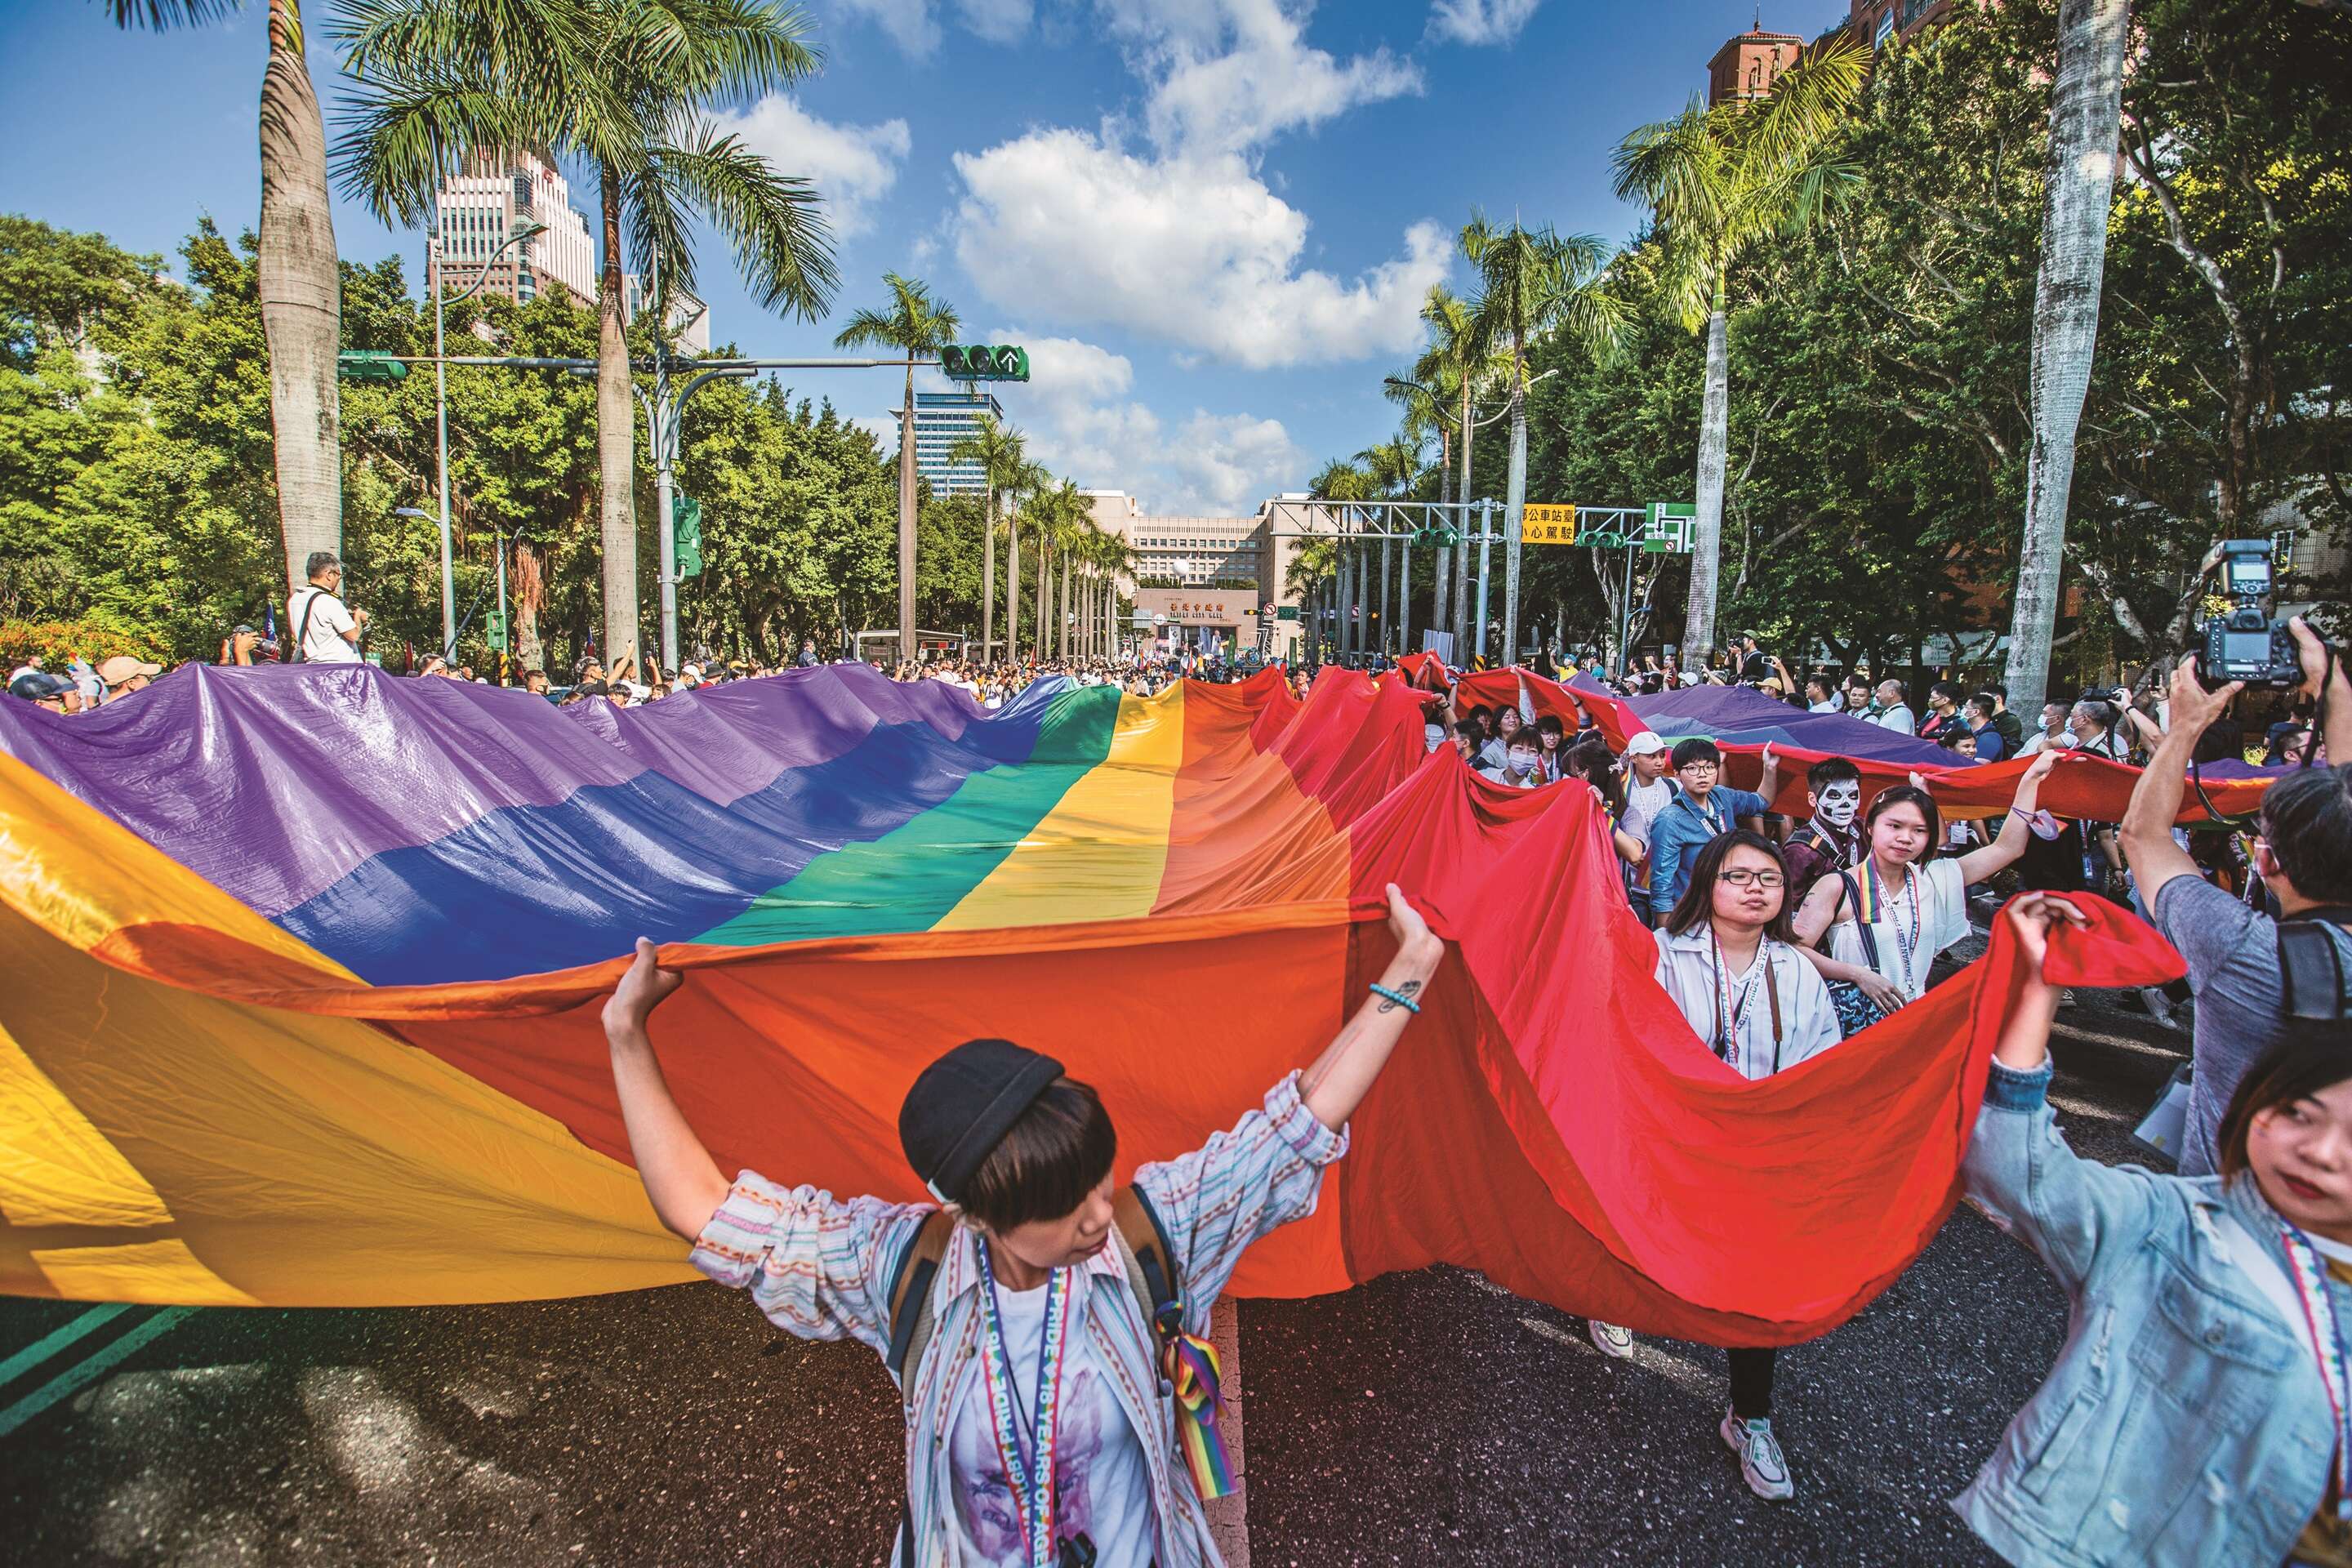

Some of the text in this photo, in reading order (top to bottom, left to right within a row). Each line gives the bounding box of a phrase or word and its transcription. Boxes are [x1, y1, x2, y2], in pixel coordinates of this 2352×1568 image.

[1886, 905, 1900, 927] PRIDE
[1897, 928, 1906, 947] LGBT
[1901, 947, 1912, 978] TAIWAN
[1746, 980, 1759, 1006] PRIDE
[1722, 994, 1732, 1027] YEARS
[1726, 1027, 1734, 1041] OF
[1045, 1292, 1065, 1358] PRIDE
[1038, 1382, 1056, 1404] 18
[990, 1376, 1015, 1444] PRIDE
[1034, 1409, 1054, 1485] YEARS
[1002, 1449, 1030, 1493] LGBT
[1033, 1488, 1049, 1517] OF
[1033, 1521, 1049, 1565] AGE
